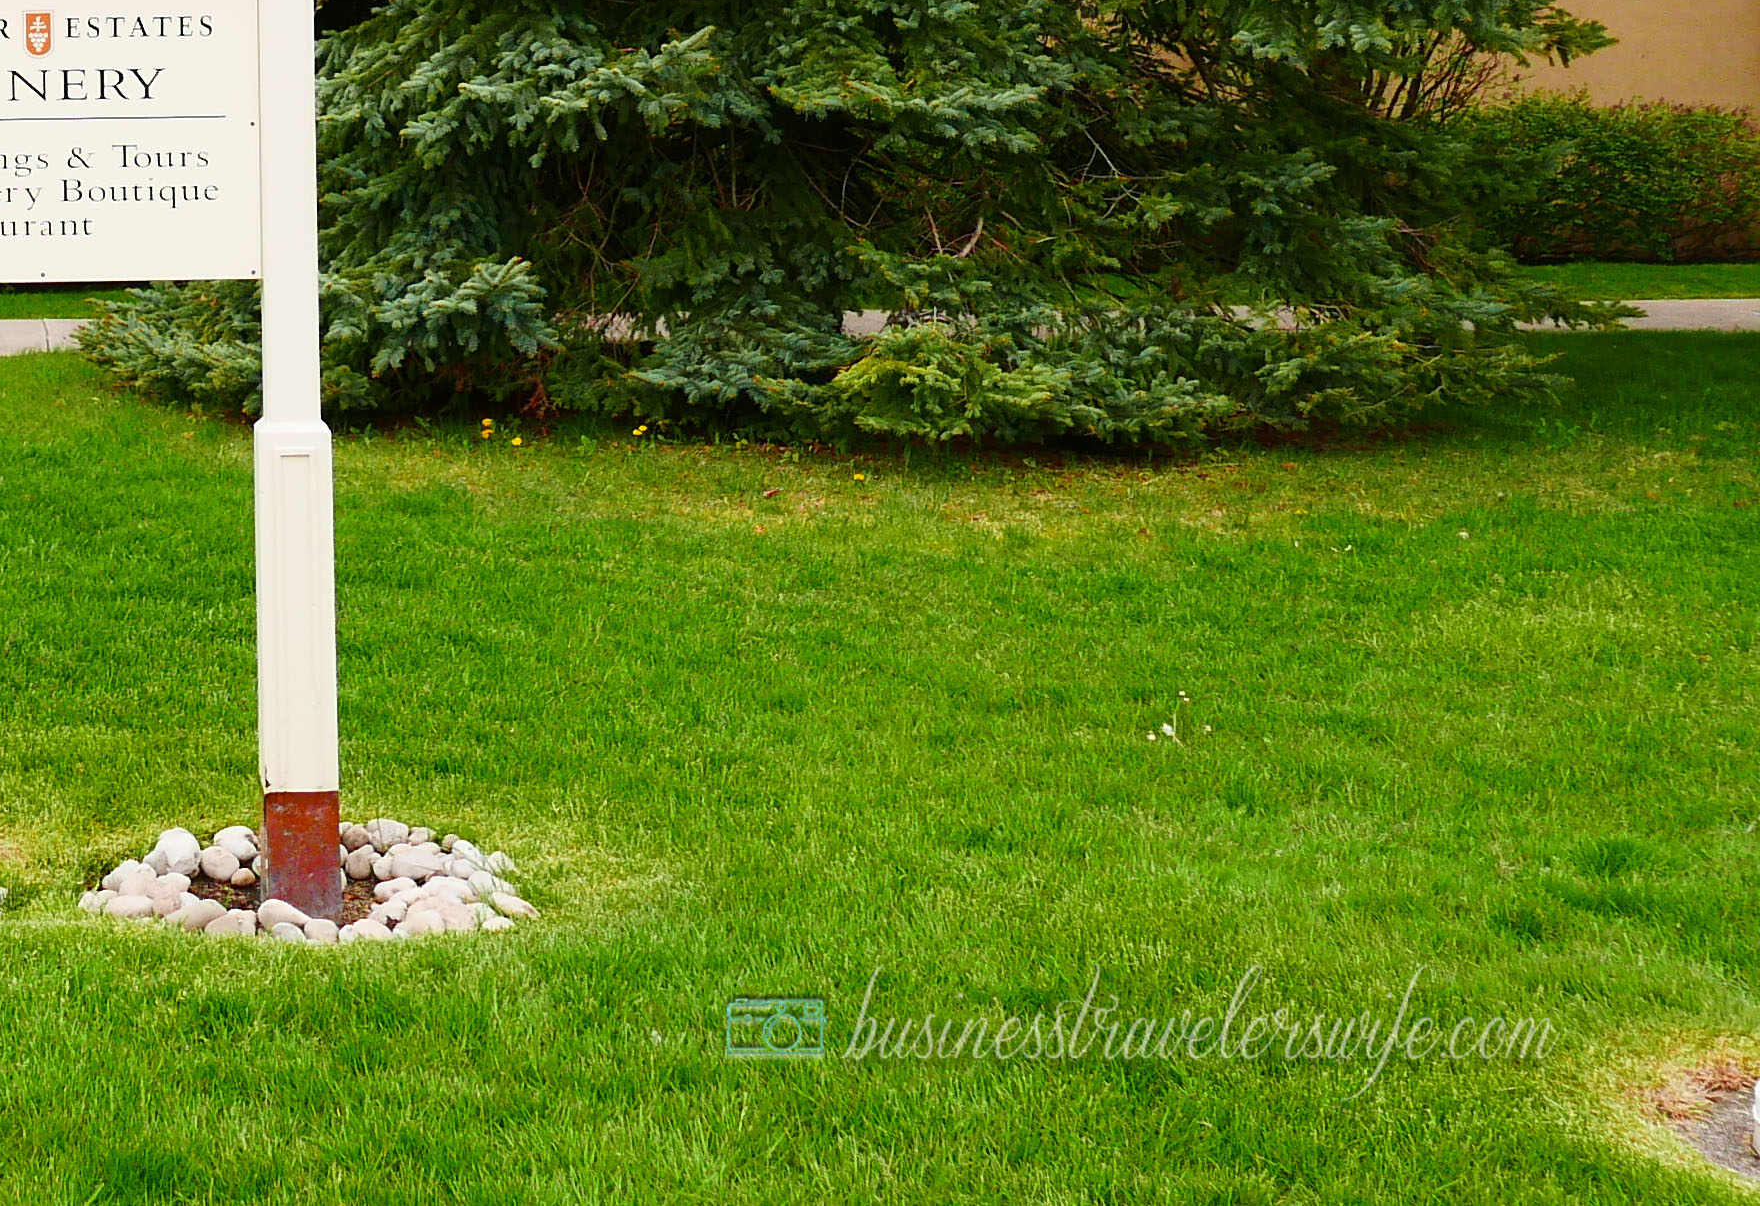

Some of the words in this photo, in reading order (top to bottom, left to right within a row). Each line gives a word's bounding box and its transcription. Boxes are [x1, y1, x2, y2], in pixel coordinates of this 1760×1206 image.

[65, 15, 214, 39] ESTATES
[66, 147, 95, 169] &
[111, 144, 210, 170] Tours
[61, 177, 220, 209] Boutique
